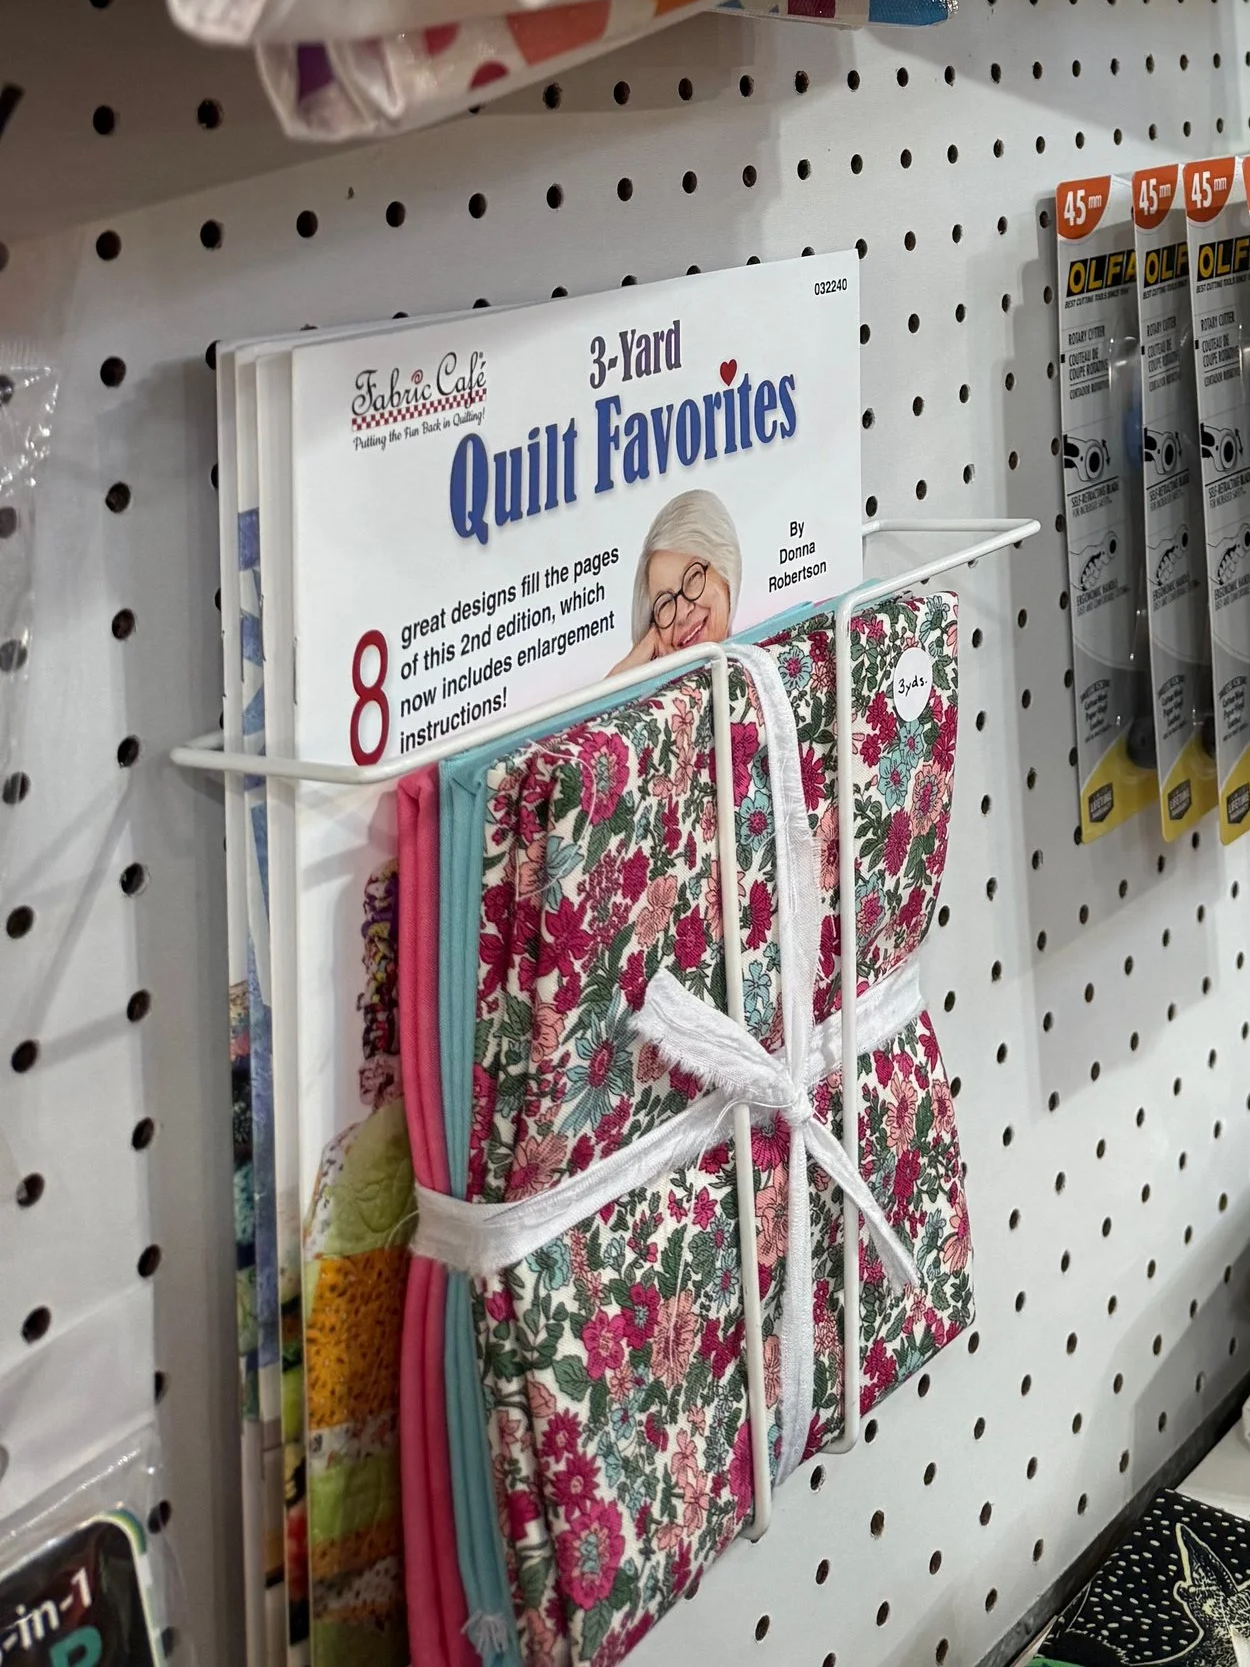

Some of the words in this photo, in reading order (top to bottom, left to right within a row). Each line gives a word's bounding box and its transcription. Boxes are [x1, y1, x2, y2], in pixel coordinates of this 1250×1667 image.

[1064, 189, 1086, 227] 45
[1088, 194, 1102, 209] mm
[1139, 178, 1158, 216] 45
[1159, 183, 1171, 197] mm
[1191, 171, 1213, 209] 45
[1214, 176, 1227, 191] mm
[813, 278, 848, 296] 032240
[1144, 243, 1188, 285] OLF
[589, 319, 682, 389] 3-Yard
[352, 367, 433, 416] Fabric
[437, 351, 487, 409] Café
[353, 434, 387, 451] Putting
[389, 429, 402, 443] the
[404, 426, 419, 439] Fun
[422, 418, 441, 435] Back
[443, 418, 450, 429] in
[452, 407, 486, 426] Quilting!
[449, 417, 578, 546] Quilt
[594, 362, 797, 494] Favorites
[779, 541, 816, 565] Donna
[789, 521, 805, 538] By
[401, 607, 447, 649] great
[451, 585, 517, 624] designs
[521, 571, 540, 598] fill
[545, 565, 569, 589] the
[573, 547, 619, 583] pages
[768, 561, 827, 593] Robertson
[400, 654, 419, 680] of
[424, 642, 456, 671] this
[460, 624, 492, 656] 2nd
[496, 605, 556, 641] edition,
[560, 582, 605, 616] which
[400, 687, 437, 717] now
[442, 654, 513, 700] includes
[517, 610, 615, 666] enlargement
[350, 629, 390, 766] 8
[400, 687, 508, 754] instructions!
[0, 1567, 92, 1667] -in-1
